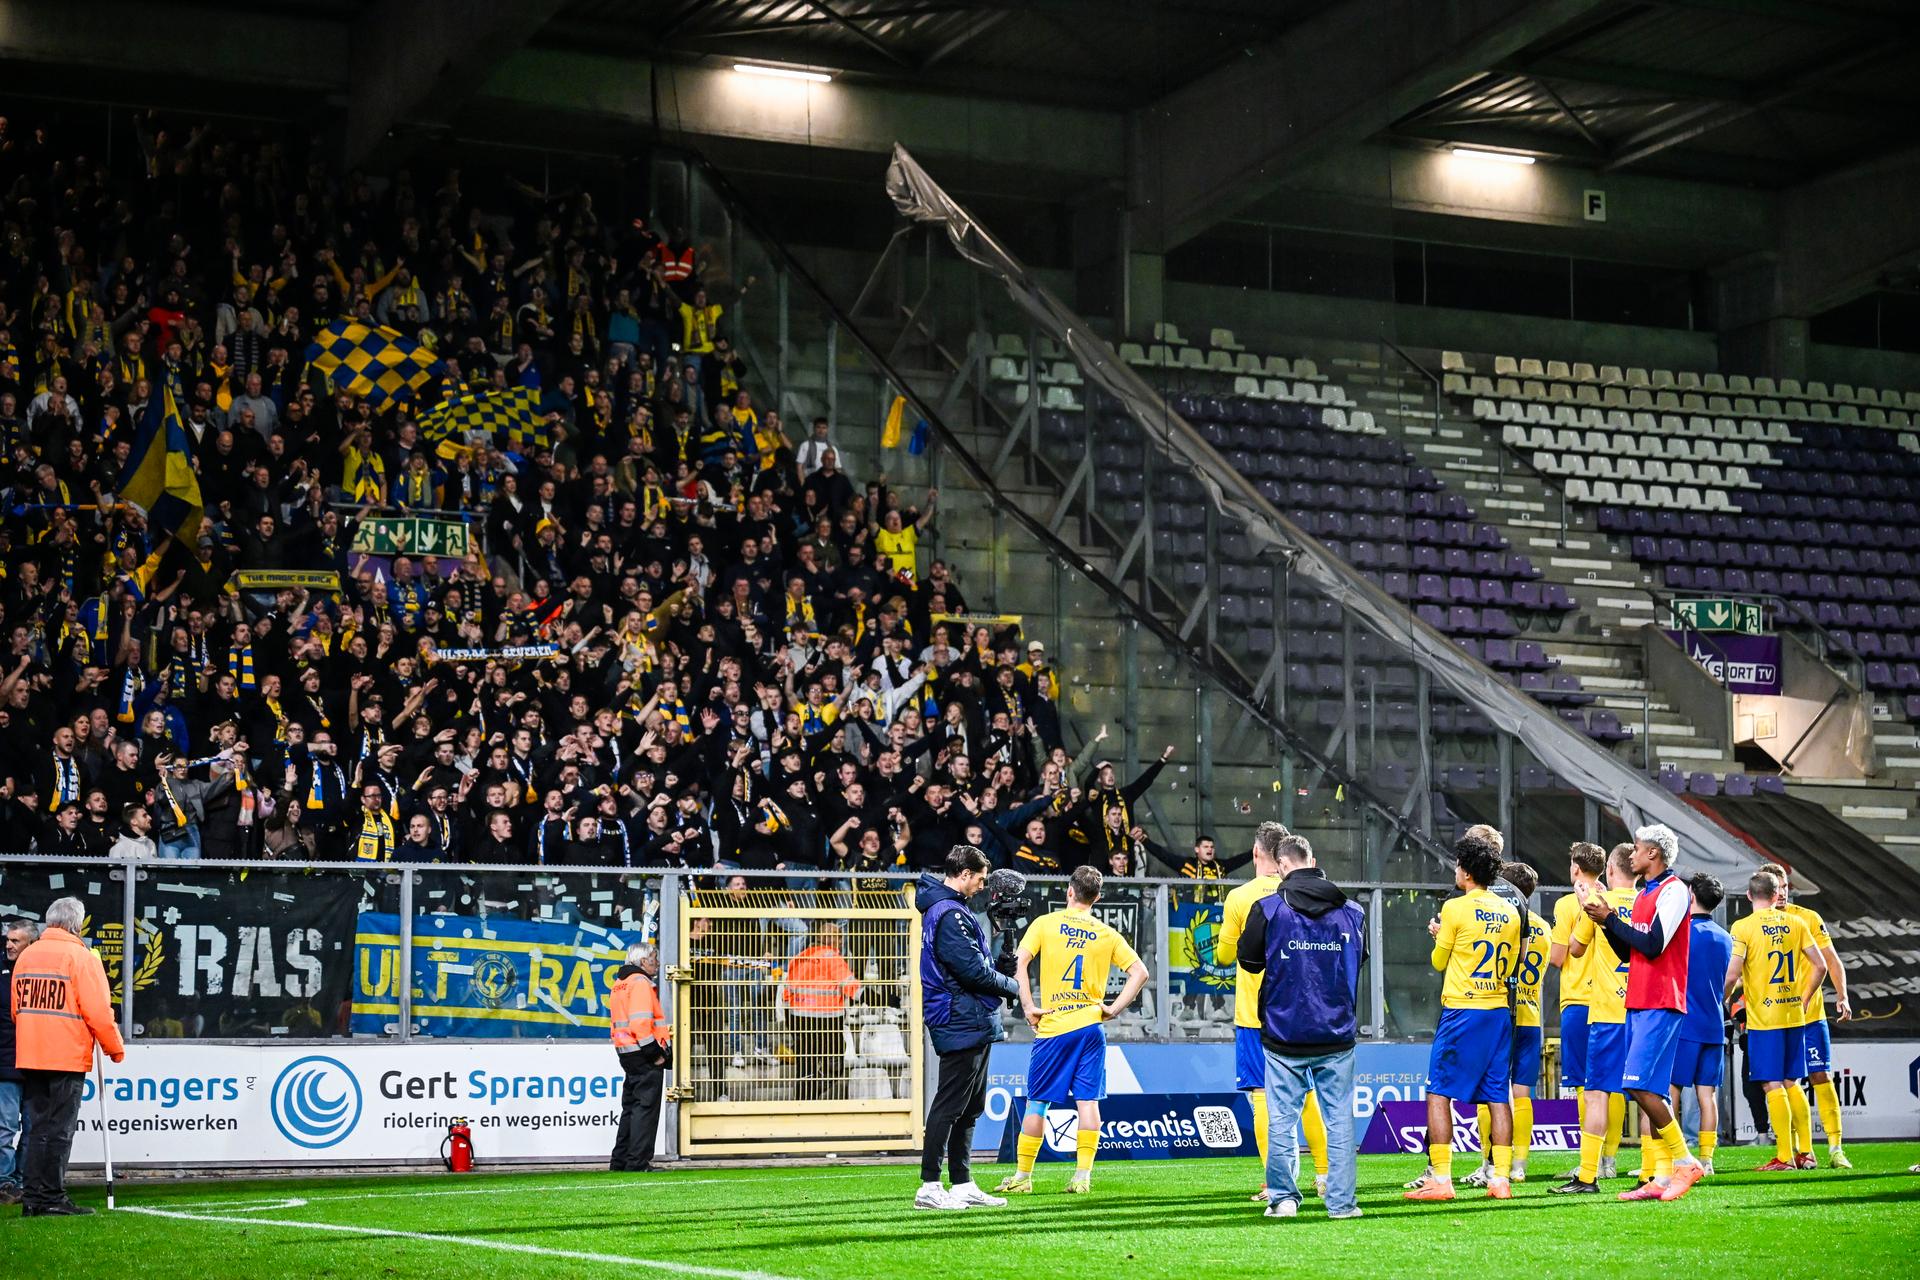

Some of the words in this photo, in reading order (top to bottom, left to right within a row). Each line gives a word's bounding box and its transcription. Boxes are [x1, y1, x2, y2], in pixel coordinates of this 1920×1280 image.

[1589, 195, 1601, 214] F
[1759, 668, 1773, 681] TV
[1475, 908, 1510, 924] Remo
[1060, 923, 1097, 941] Remo
[1761, 925, 1791, 936] Remo
[1066, 937, 1086, 949] Frit
[1288, 939, 1342, 952] Clubmedia
[175, 924, 324, 998] RAS
[1469, 940, 1512, 981] 26
[1519, 950, 1543, 987] 8
[1767, 949, 1795, 985] 21
[1061, 954, 1084, 990] 4
[81, 1077, 239, 1108] angers
[379, 1070, 458, 1100] Gert
[468, 1070, 624, 1106] Spranger
[92, 1113, 238, 1135] wegeniswerken
[480, 1115, 500, 1128] en
[506, 1110, 620, 1130] wegeniswerk
[1097, 1138, 1145, 1150] connect
[1149, 1137, 1168, 1149] the
[1174, 1136, 1200, 1148] dots
